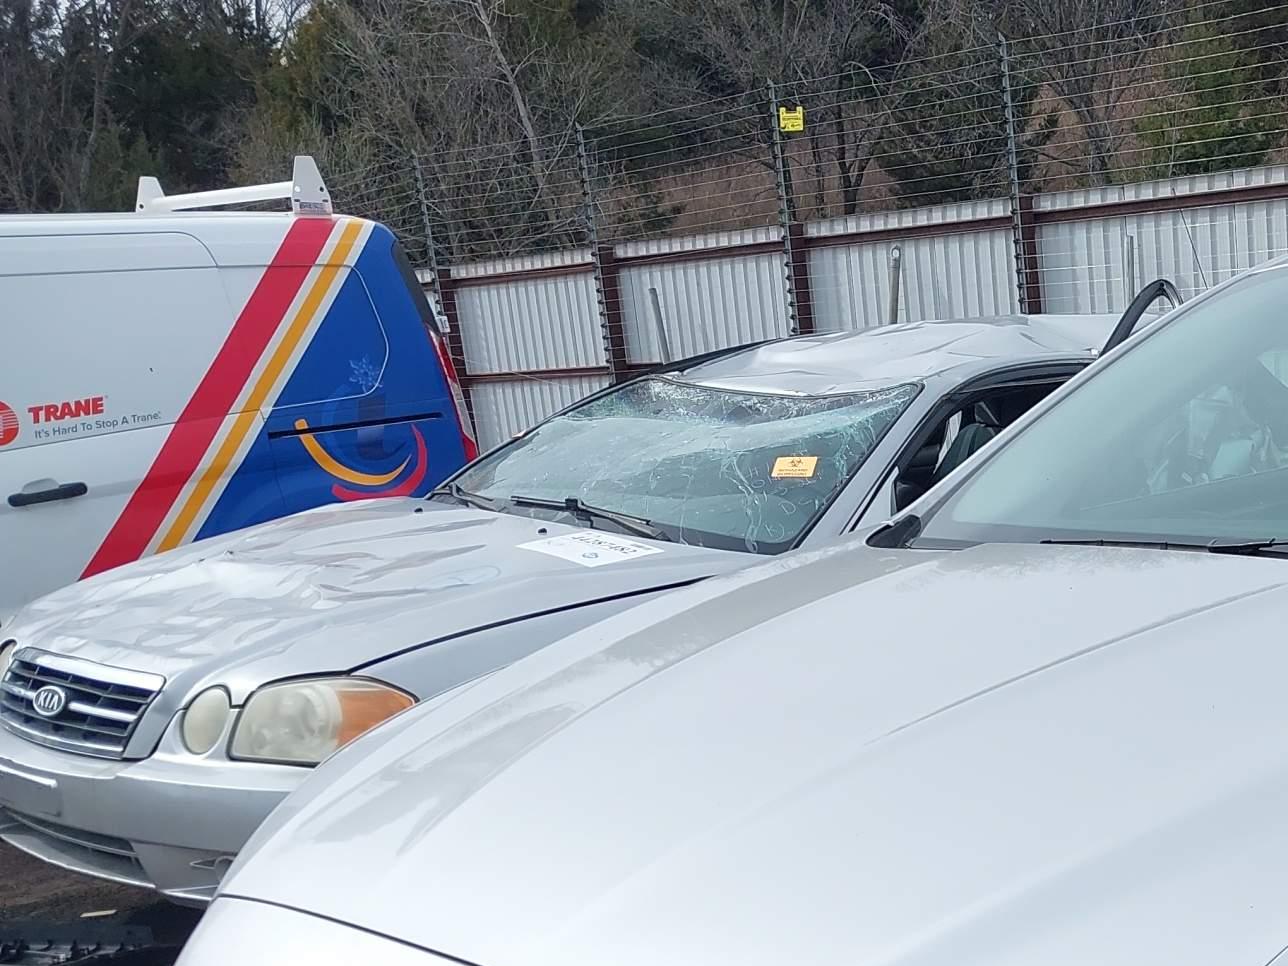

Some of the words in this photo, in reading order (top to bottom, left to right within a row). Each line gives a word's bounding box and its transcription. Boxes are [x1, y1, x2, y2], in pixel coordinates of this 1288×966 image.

[28, 396, 105, 425] TRANE
[34, 428, 51, 440] It's
[52, 425, 78, 437] Hard
[81, 422, 93, 432] To
[95, 418, 119, 430] Stop
[121, 415, 129, 425] A
[37, 690, 60, 712] KIA
